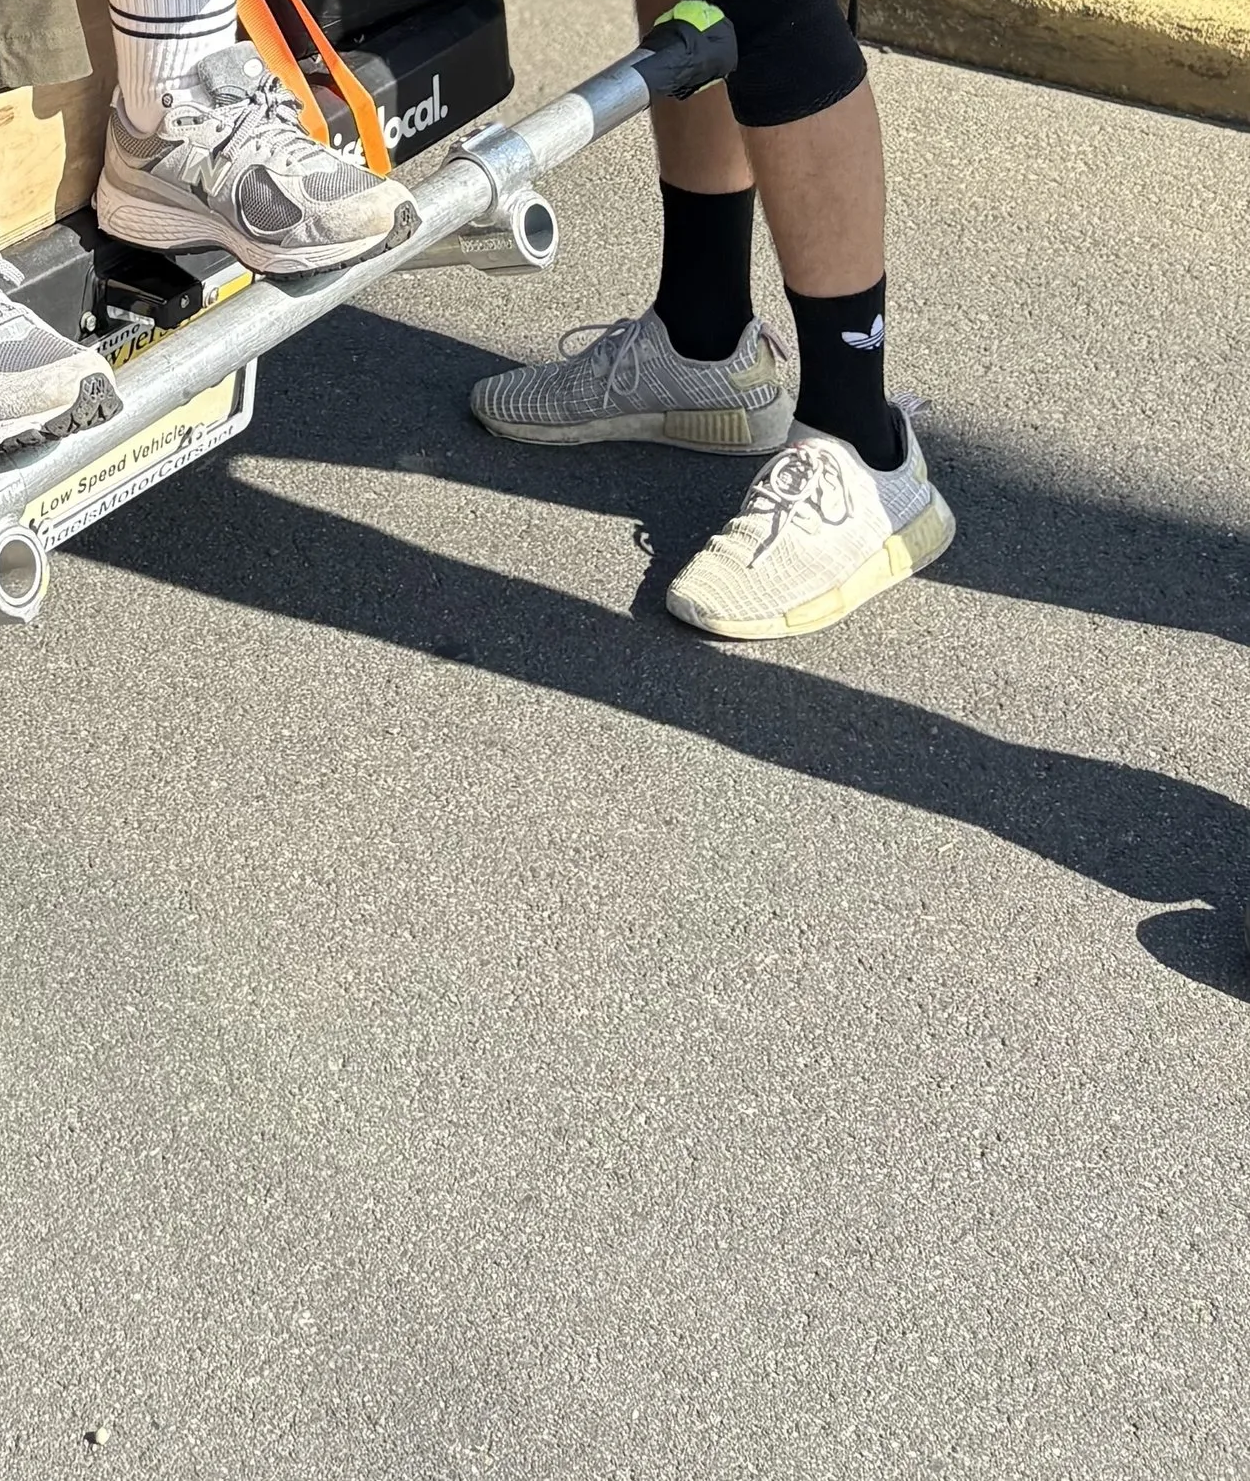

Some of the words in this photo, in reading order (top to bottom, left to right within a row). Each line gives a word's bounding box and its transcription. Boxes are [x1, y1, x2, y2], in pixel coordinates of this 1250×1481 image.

[377, 73, 449, 149] local.
[39, 487, 73, 518] Low
[76, 453, 128, 497] Speed
[131, 424, 186, 463] Vehicle
[43, 424, 235, 550] haelsMotorCars.net
